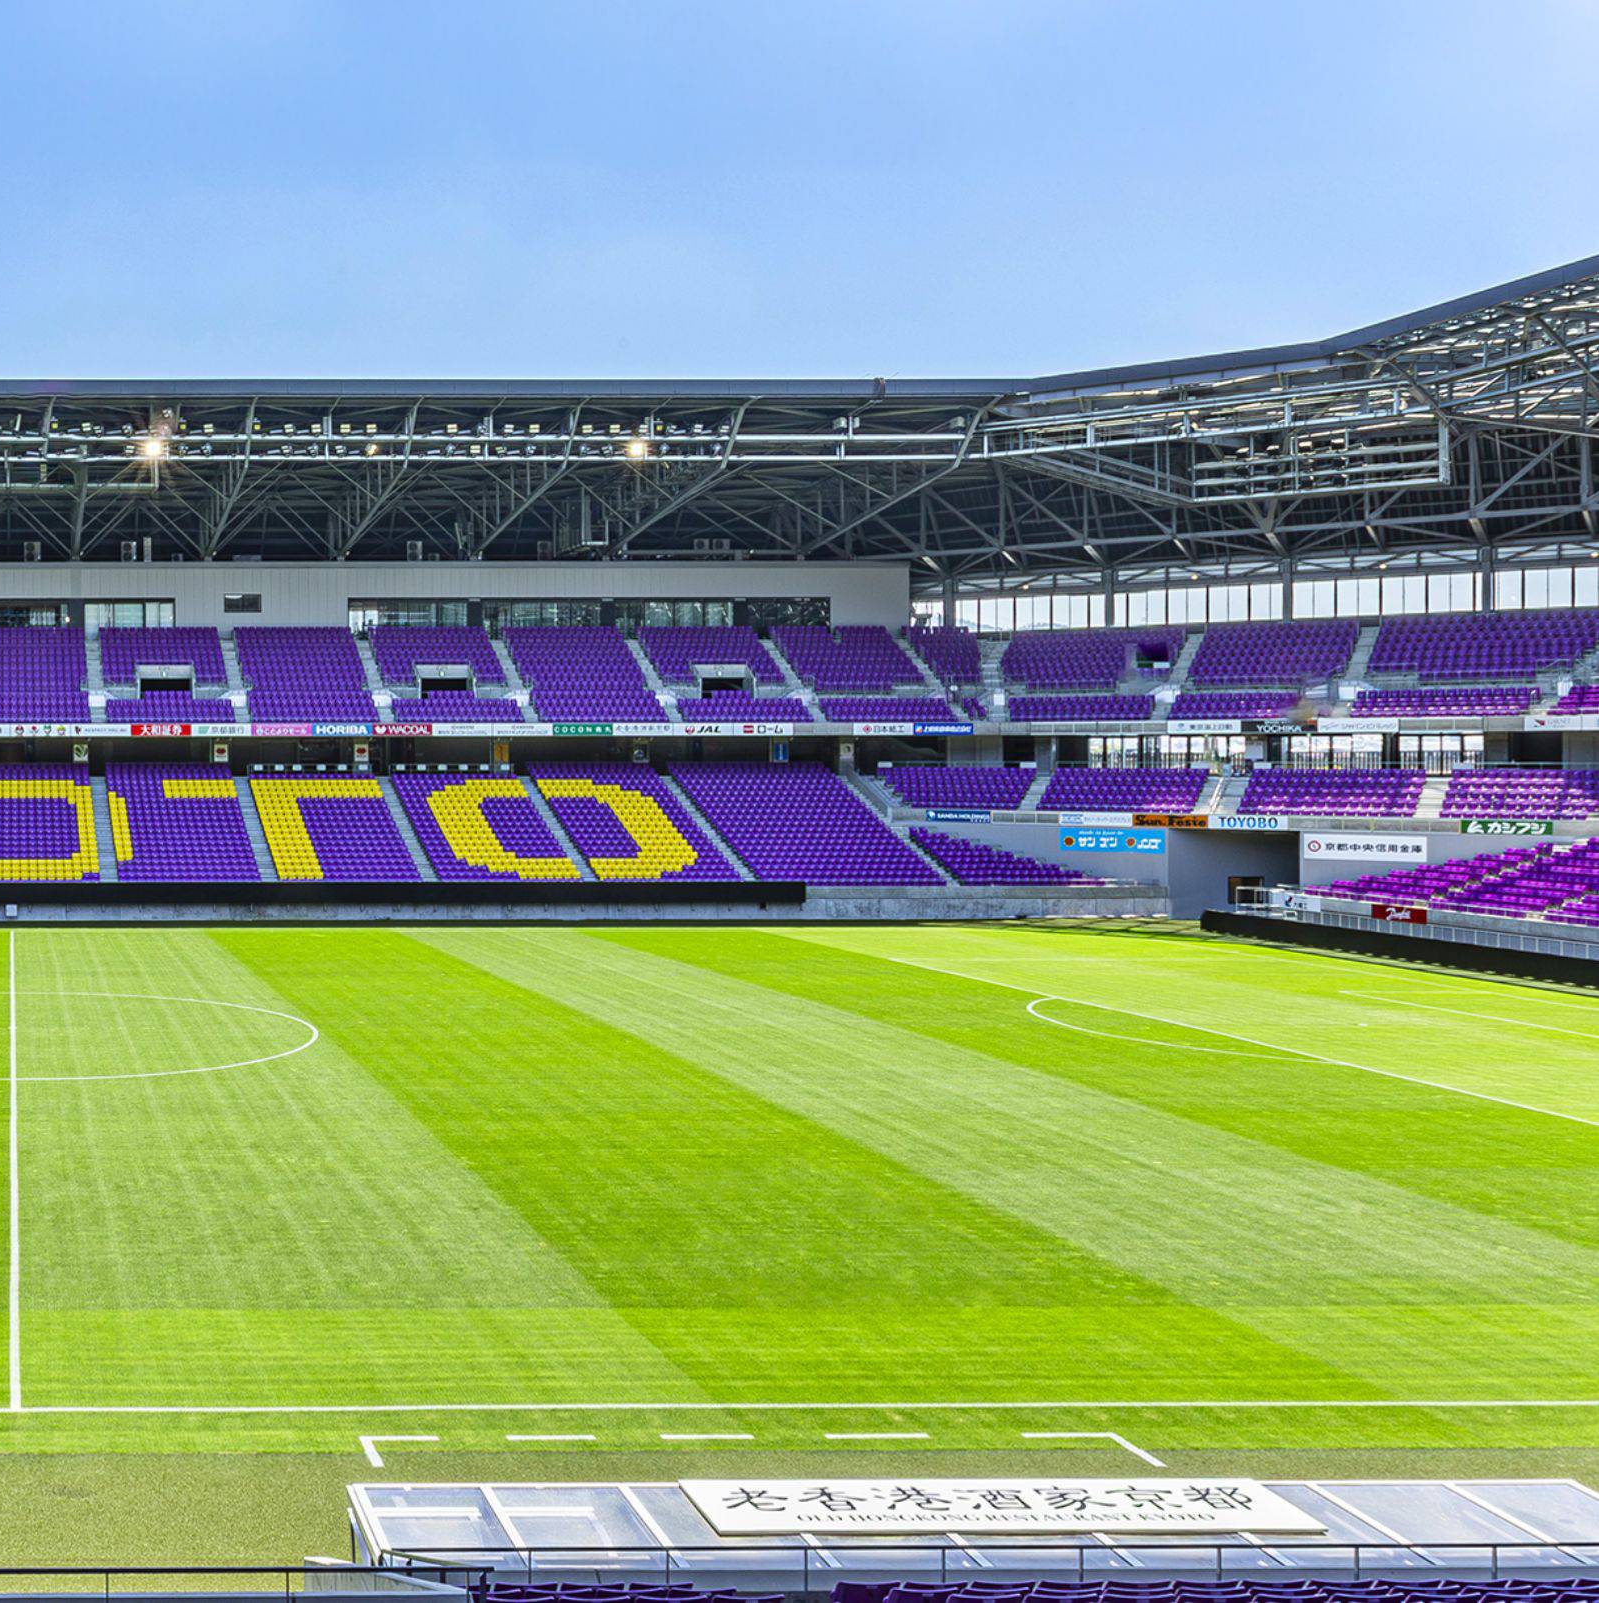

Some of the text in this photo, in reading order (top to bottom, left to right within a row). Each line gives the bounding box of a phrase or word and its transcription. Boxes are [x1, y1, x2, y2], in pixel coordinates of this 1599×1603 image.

[140, 724, 183, 736] 大和証券
[316, 724, 368, 735] HORIBA
[387, 724, 430, 735] WACOAL
[553, 726, 592, 734] COCON
[697, 725, 722, 734] JAL
[1219, 816, 1278, 829] TOYOBO
[1325, 843, 1423, 853] 京都中央信用金庫
[721, 1485, 1257, 1514] 老香港酒家京都
